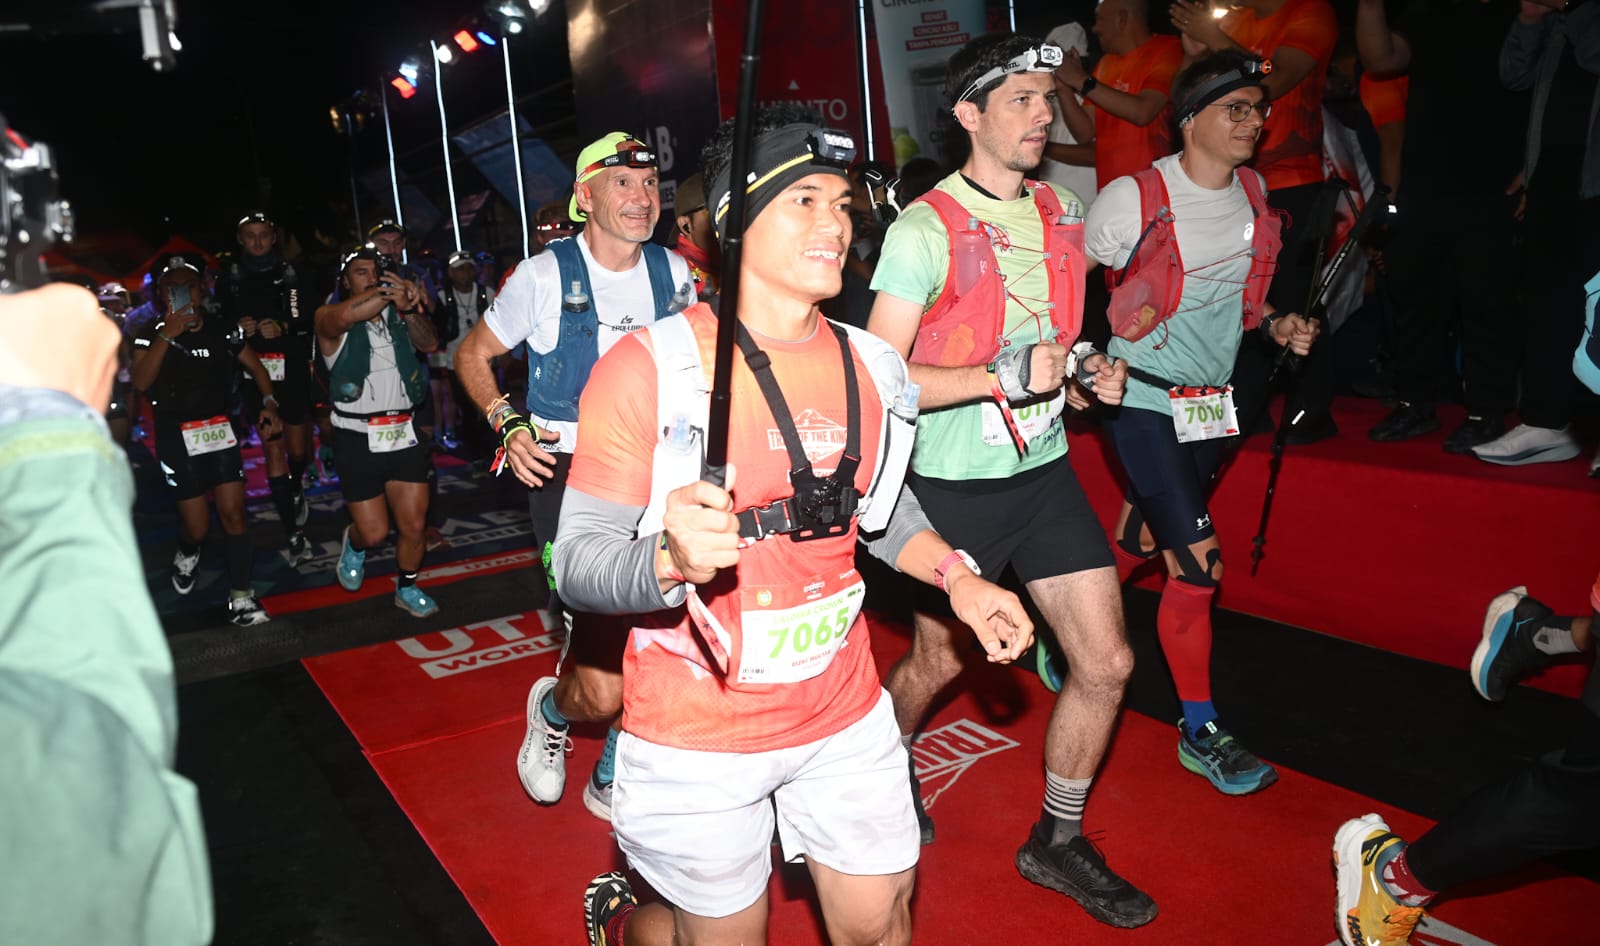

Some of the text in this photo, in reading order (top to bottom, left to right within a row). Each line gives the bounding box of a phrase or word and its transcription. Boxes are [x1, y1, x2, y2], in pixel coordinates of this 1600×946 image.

[1184, 404, 1224, 425] 7016
[192, 429, 226, 445] 7060
[812, 431, 828, 443] THE
[767, 607, 849, 659] 7065
